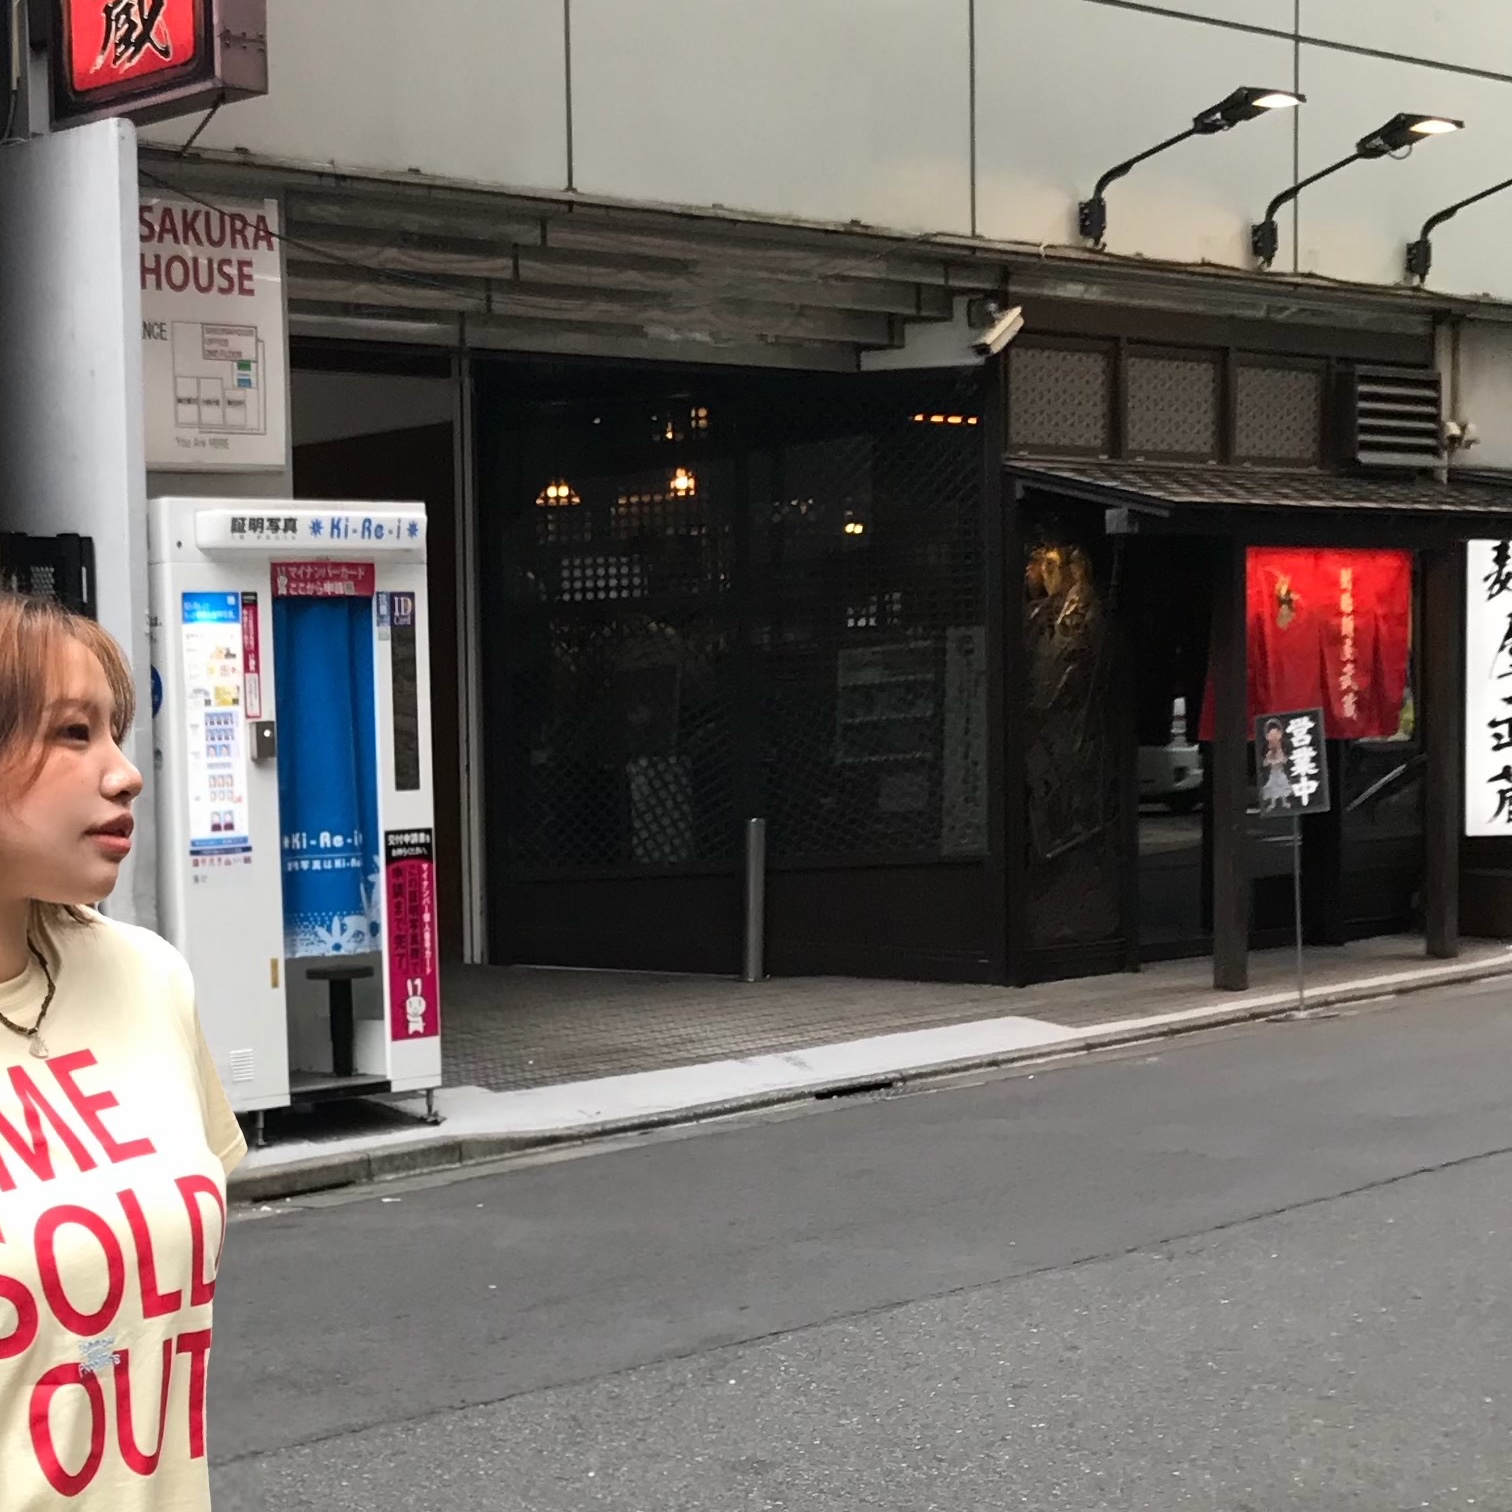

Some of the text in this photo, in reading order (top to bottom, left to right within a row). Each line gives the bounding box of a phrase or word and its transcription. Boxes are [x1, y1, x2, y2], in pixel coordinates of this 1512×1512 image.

[139, 205, 274, 251] SAKURA
[140, 253, 255, 297] HOUSE
[230, 517, 298, 535] 証明写真
[393, 596, 413, 616] ID
[1286, 715, 1320, 807] 営業中
[28, 1328, 212, 1498] OUT
